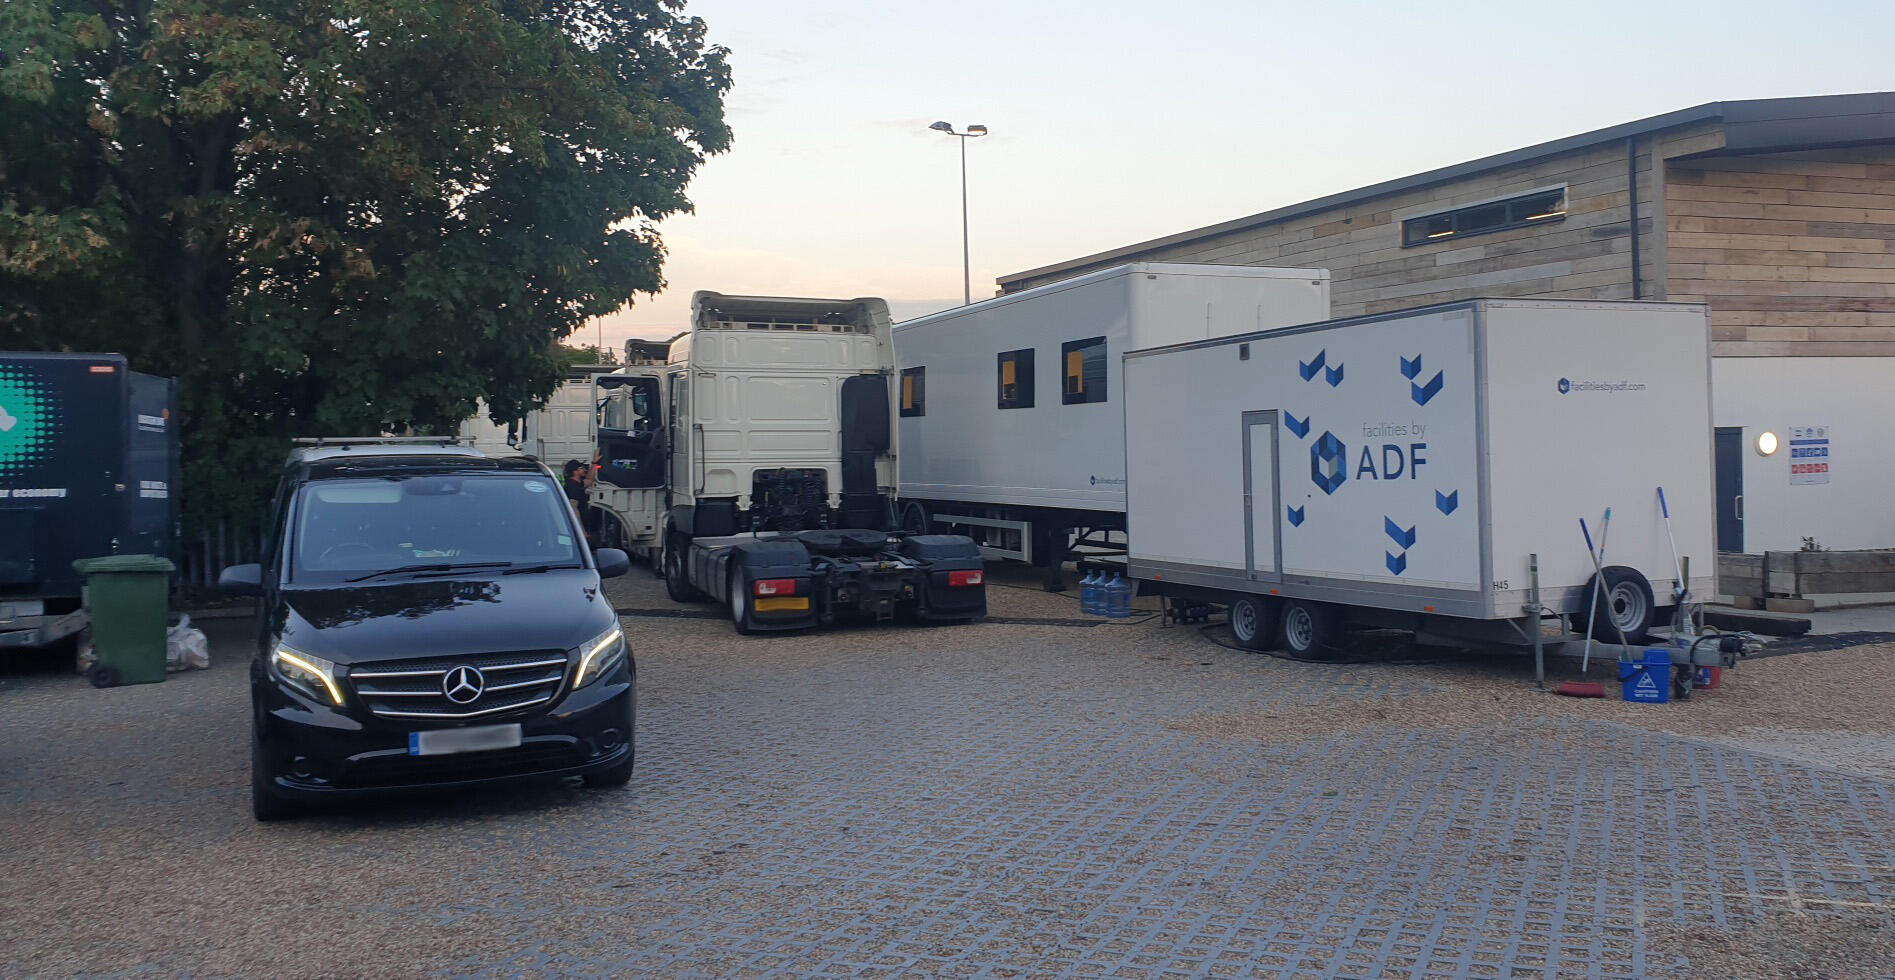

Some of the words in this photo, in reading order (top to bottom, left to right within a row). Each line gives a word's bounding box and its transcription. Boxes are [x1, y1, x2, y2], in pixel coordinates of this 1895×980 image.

[1571, 380, 1647, 394] facilitiesbyadf.com
[1361, 422, 1407, 437] facilities
[1411, 419, 1426, 439] by
[1355, 443, 1427, 480] ADF
